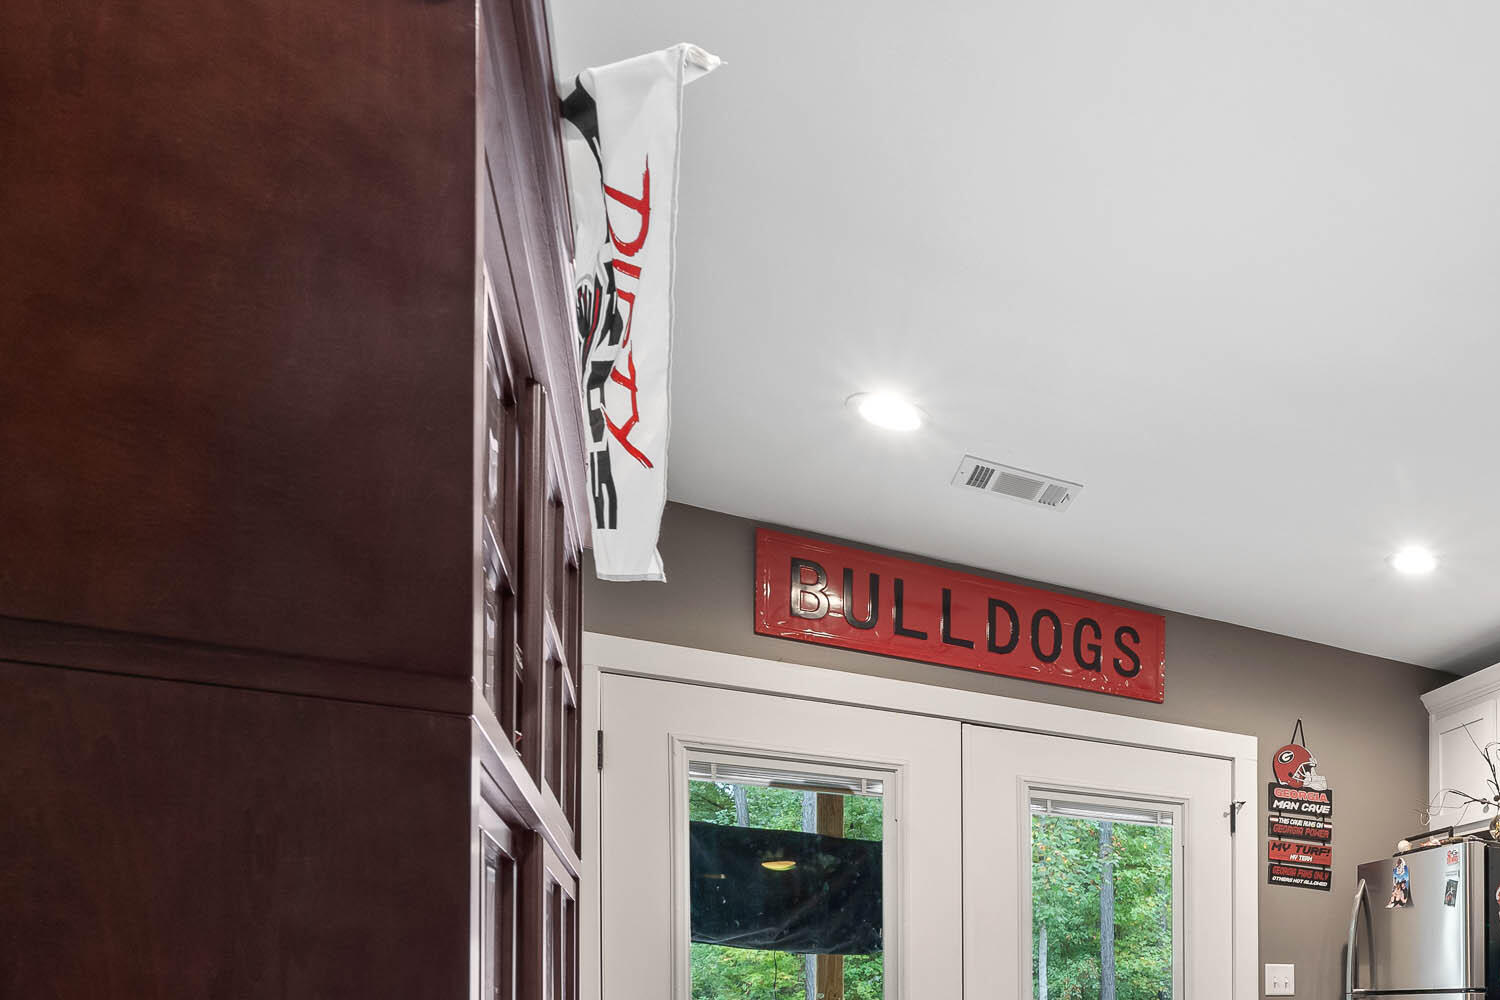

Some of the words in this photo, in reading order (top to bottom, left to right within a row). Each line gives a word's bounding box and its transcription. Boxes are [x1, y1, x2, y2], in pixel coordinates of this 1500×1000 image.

[790, 557, 1142, 679] BULLDOGS
[1279, 751, 1294, 764] G
[1274, 787, 1329, 803] GEORGIA
[1273, 799, 1299, 810] MAN
[1301, 803, 1330, 814] CAVE
[1273, 824, 1304, 835] GEORGIA
[1305, 827, 1328, 838] POWER
[1272, 842, 1291, 852] MY
[1296, 845, 1331, 857] TURF!
